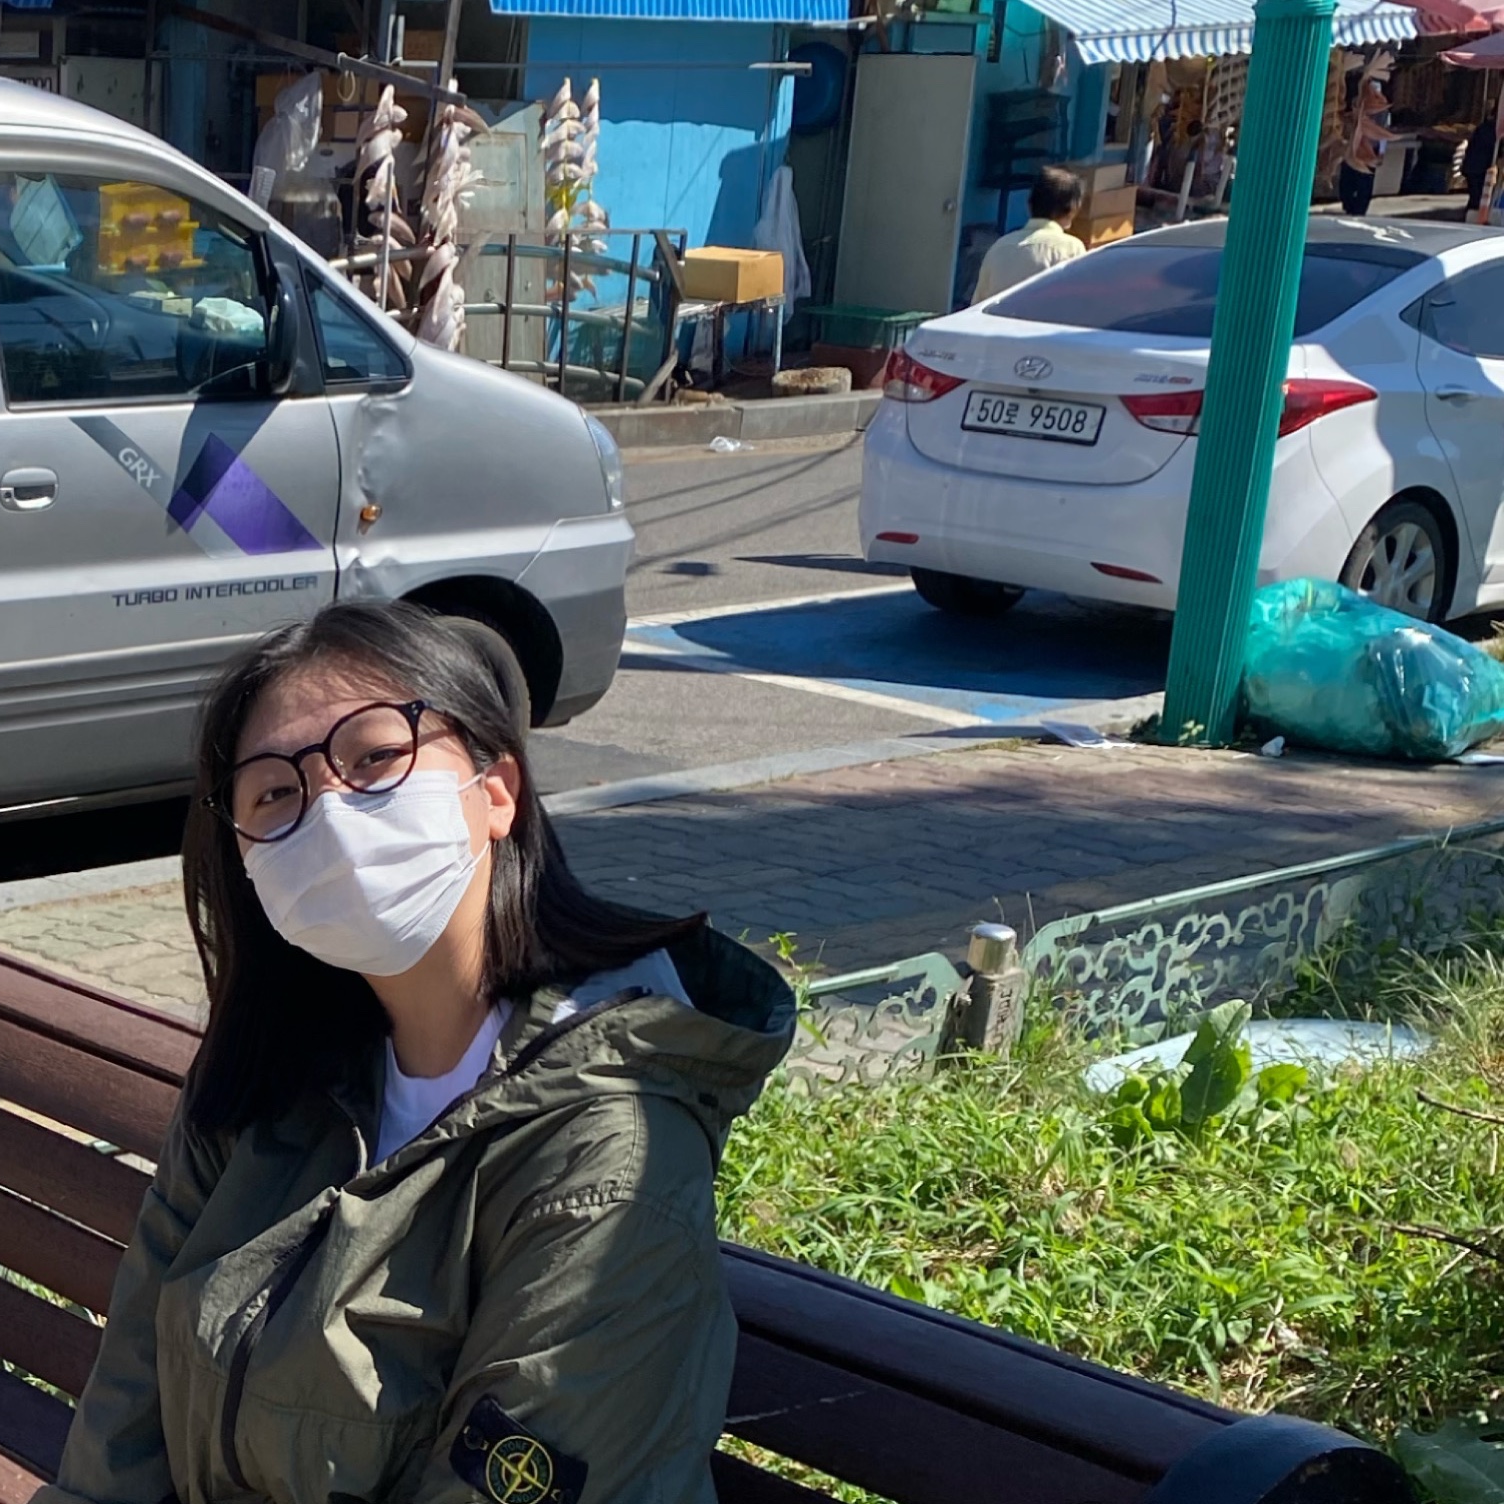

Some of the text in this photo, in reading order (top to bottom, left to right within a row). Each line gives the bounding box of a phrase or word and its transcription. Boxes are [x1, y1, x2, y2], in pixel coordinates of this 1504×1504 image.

[976, 397, 1089, 434] 50로 9508
[117, 447, 161, 488] GRX
[111, 575, 319, 607] TURBO INTERCOOLER
